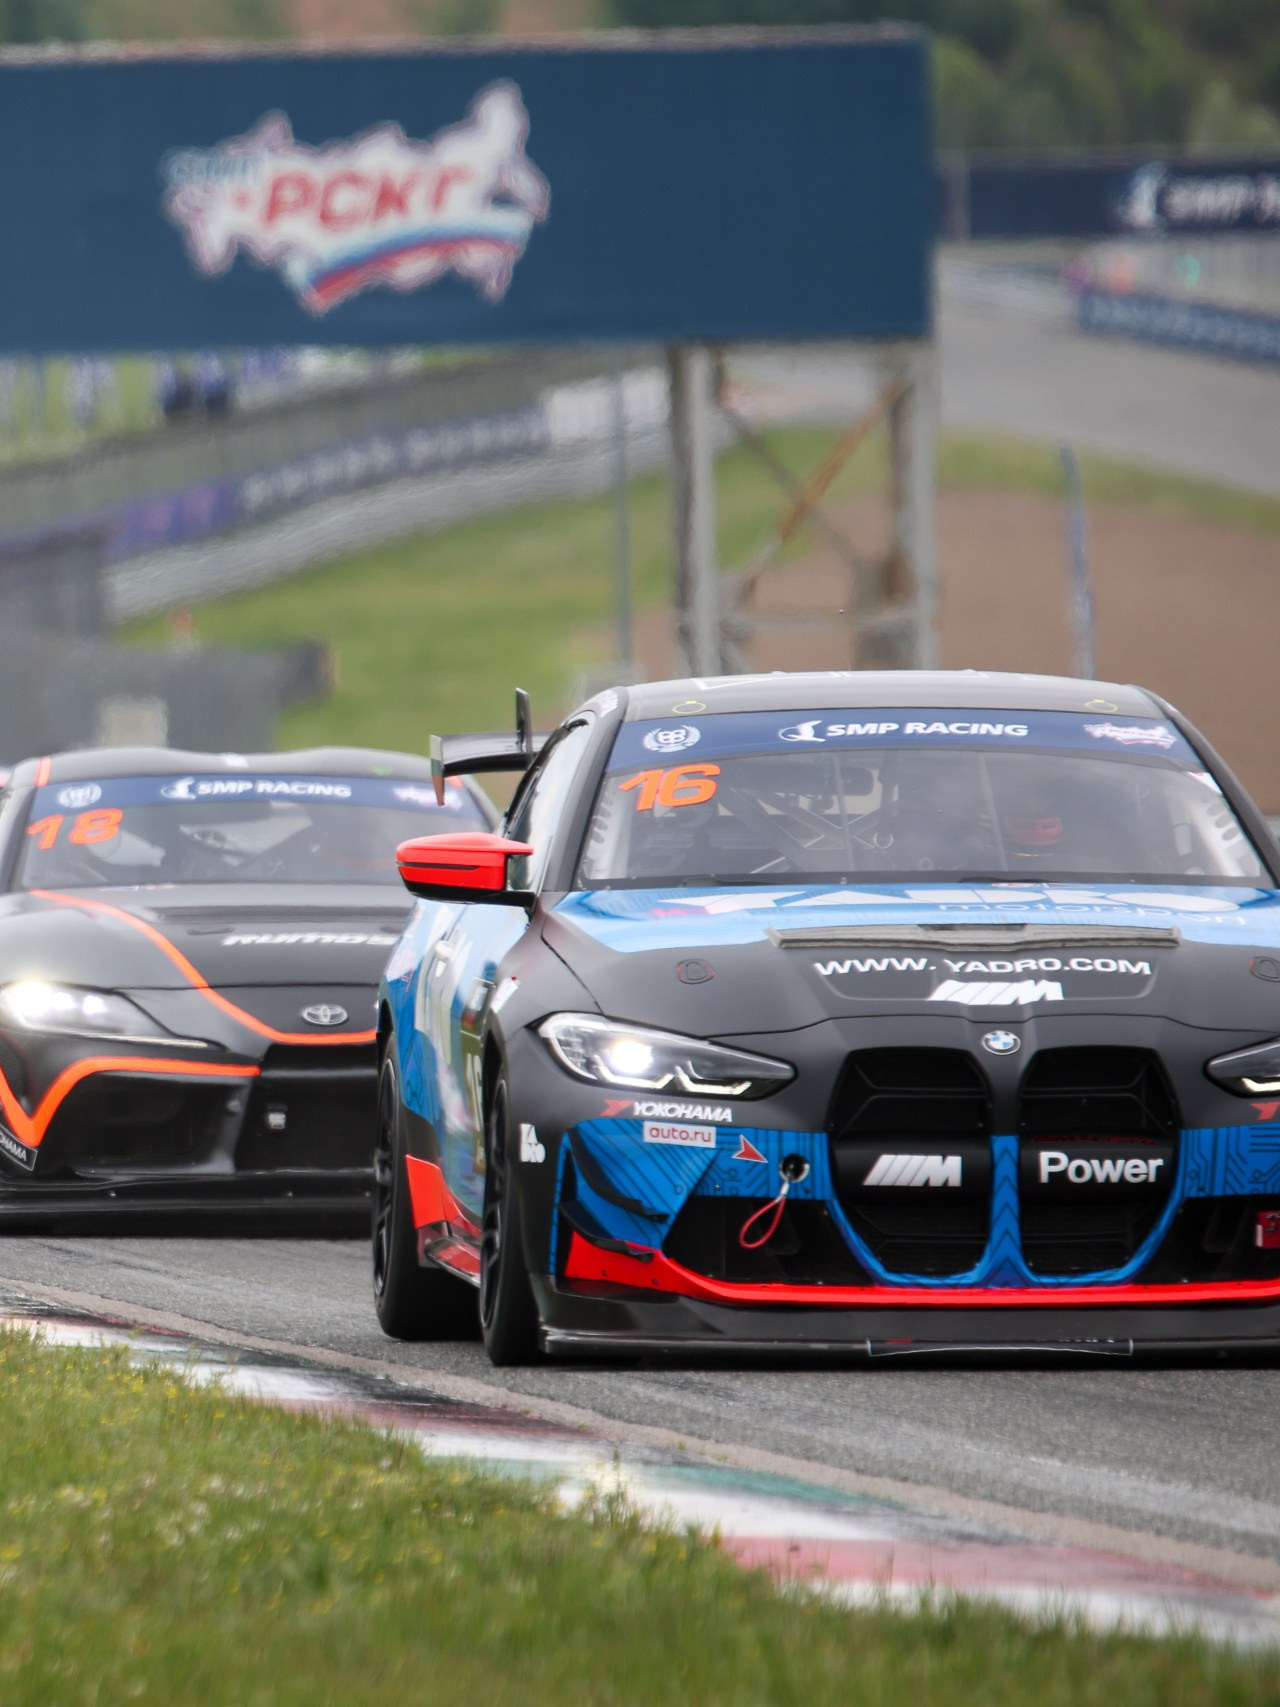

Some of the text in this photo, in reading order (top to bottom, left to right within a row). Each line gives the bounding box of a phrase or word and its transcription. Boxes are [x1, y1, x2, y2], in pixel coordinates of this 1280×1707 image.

[827, 722, 1029, 737] SMP RACING
[198, 781, 352, 798] SMP RACING
[619, 763, 721, 811] 16
[25, 808, 123, 850] 18
[939, 902, 1248, 926] motorsport
[632, 1101, 733, 1123] YOKOHAMA
[649, 1126, 713, 1143] auto.ru
[1039, 1151, 1164, 1184] Power
